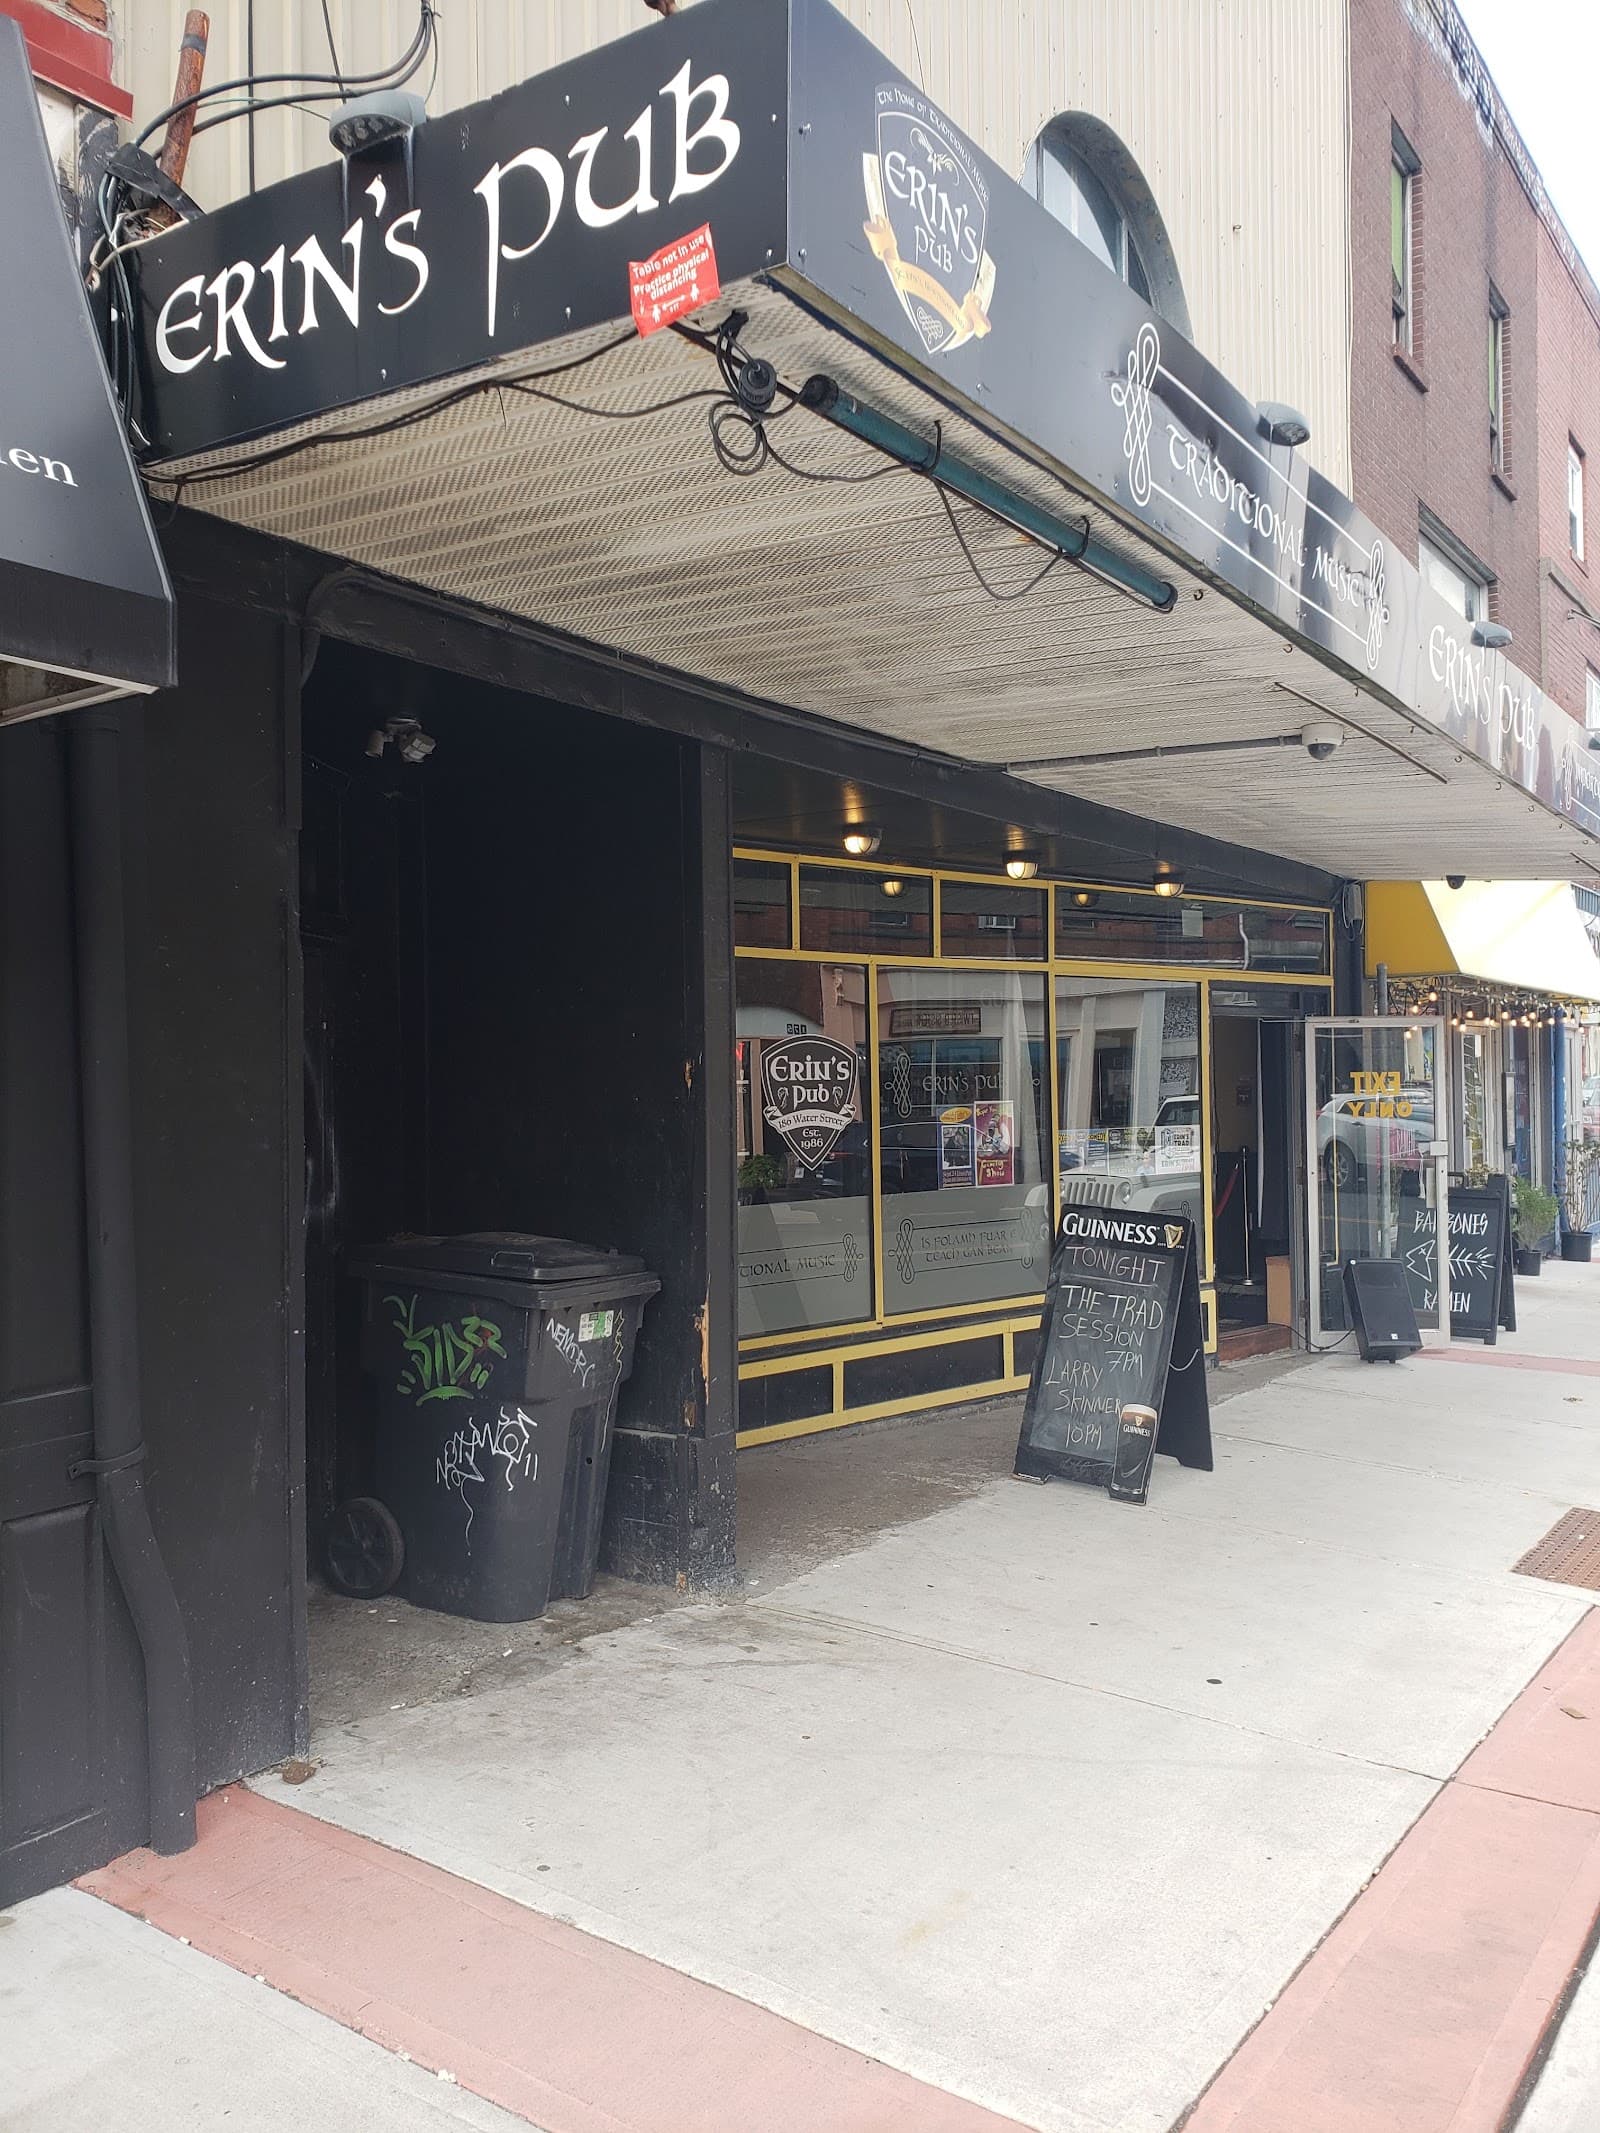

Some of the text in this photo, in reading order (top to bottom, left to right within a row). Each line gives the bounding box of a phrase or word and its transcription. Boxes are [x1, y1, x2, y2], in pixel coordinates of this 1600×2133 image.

[885, 151, 978, 264] ERIN'S
[156, 174, 429, 374] ERIN'S
[632, 234, 705, 279] Table not in use
[633, 248, 709, 297] Practice physical
[650, 267, 697, 301] distancing
[0, 448, 79, 488] en
[1167, 424, 1363, 608] TRADITIONAL MUSIC
[1429, 624, 1491, 725] ERIN'S
[770, 1055, 850, 1082] ERIN'S
[922, 1071, 969, 1096] ERIN'S
[792, 1113, 817, 1124] Water
[819, 1113, 845, 1126] Street
[800, 1138, 824, 1150] 1986
[1062, 1212, 1157, 1246] GUINNESS
[797, 1254, 836, 1271] MUSIC
[1065, 1246, 1166, 1283] TONIGHT
[1060, 1285, 1164, 1330] THE TRAD
[1058, 1313, 1145, 1348] SESSION
[1044, 1355, 1104, 1392] LARRY
[1105, 1350, 1144, 1379] 7PM
[1053, 1388, 1122, 1419] SKINNER
[1123, 1423, 1151, 1438] GUINNESS
